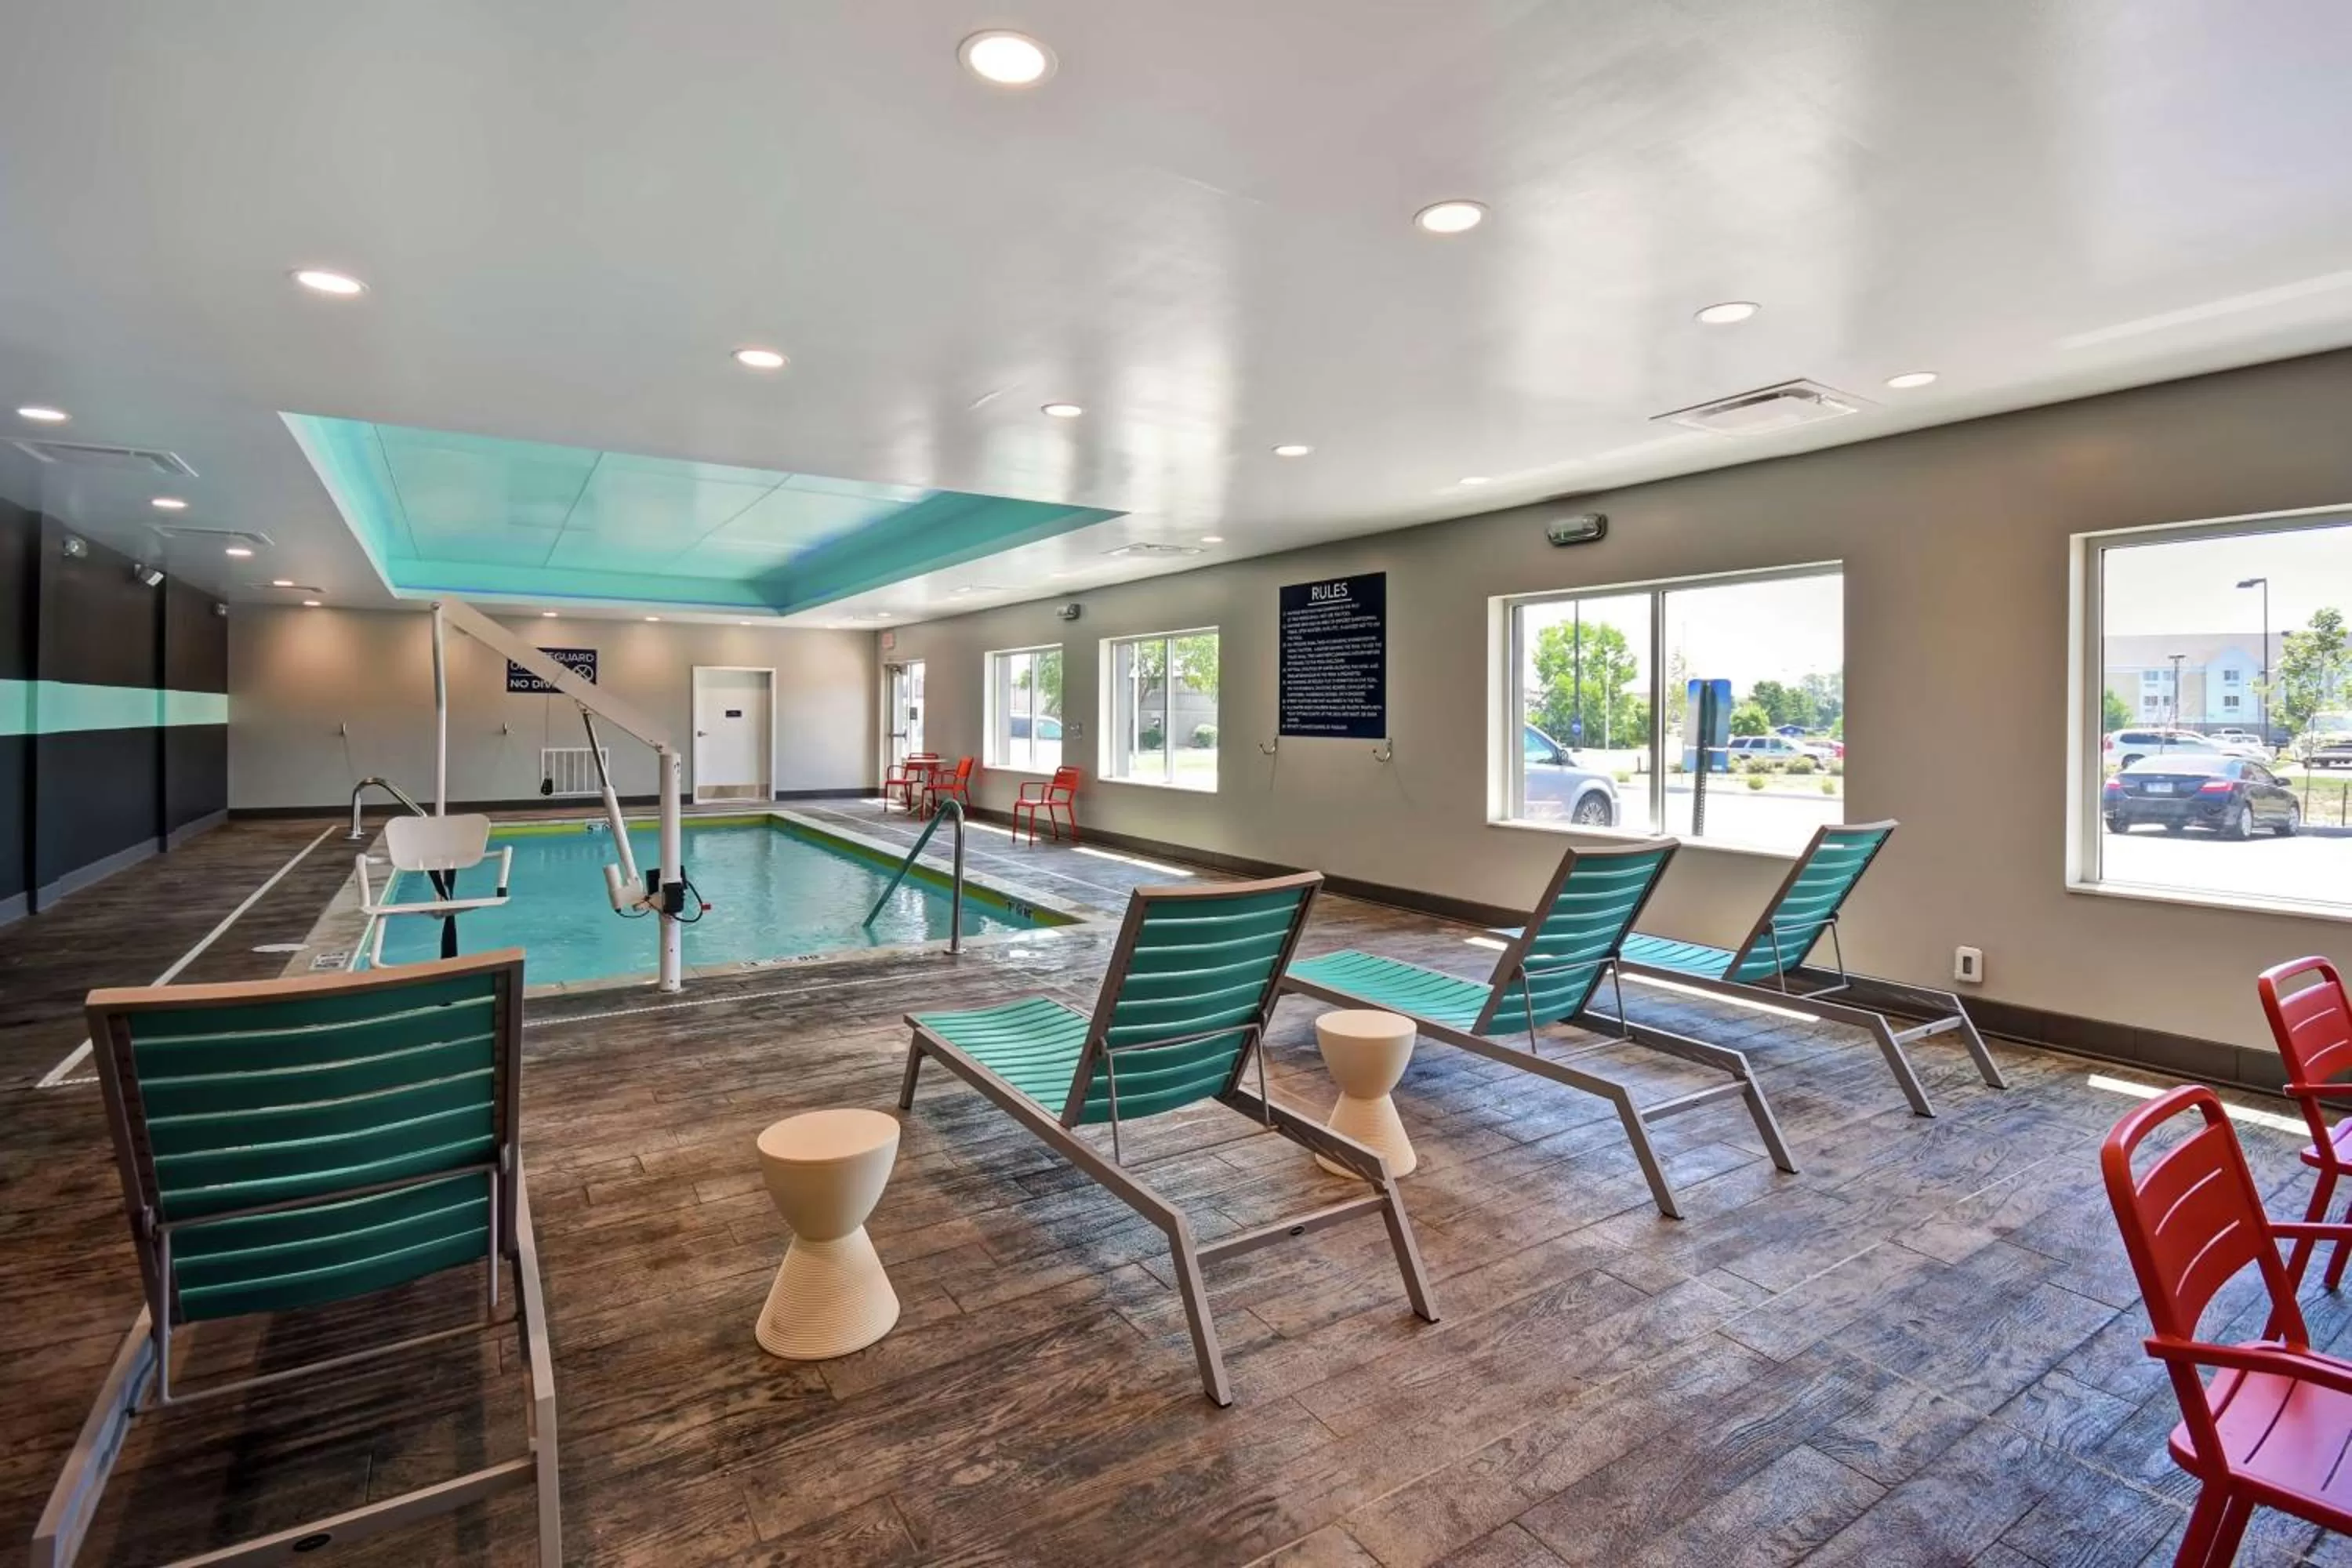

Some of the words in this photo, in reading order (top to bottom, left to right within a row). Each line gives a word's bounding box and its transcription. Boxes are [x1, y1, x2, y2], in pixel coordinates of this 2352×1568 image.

[1312, 583, 1348, 601] RULES
[510, 679, 530, 689] NO
[532, 679, 553, 689] DIV
